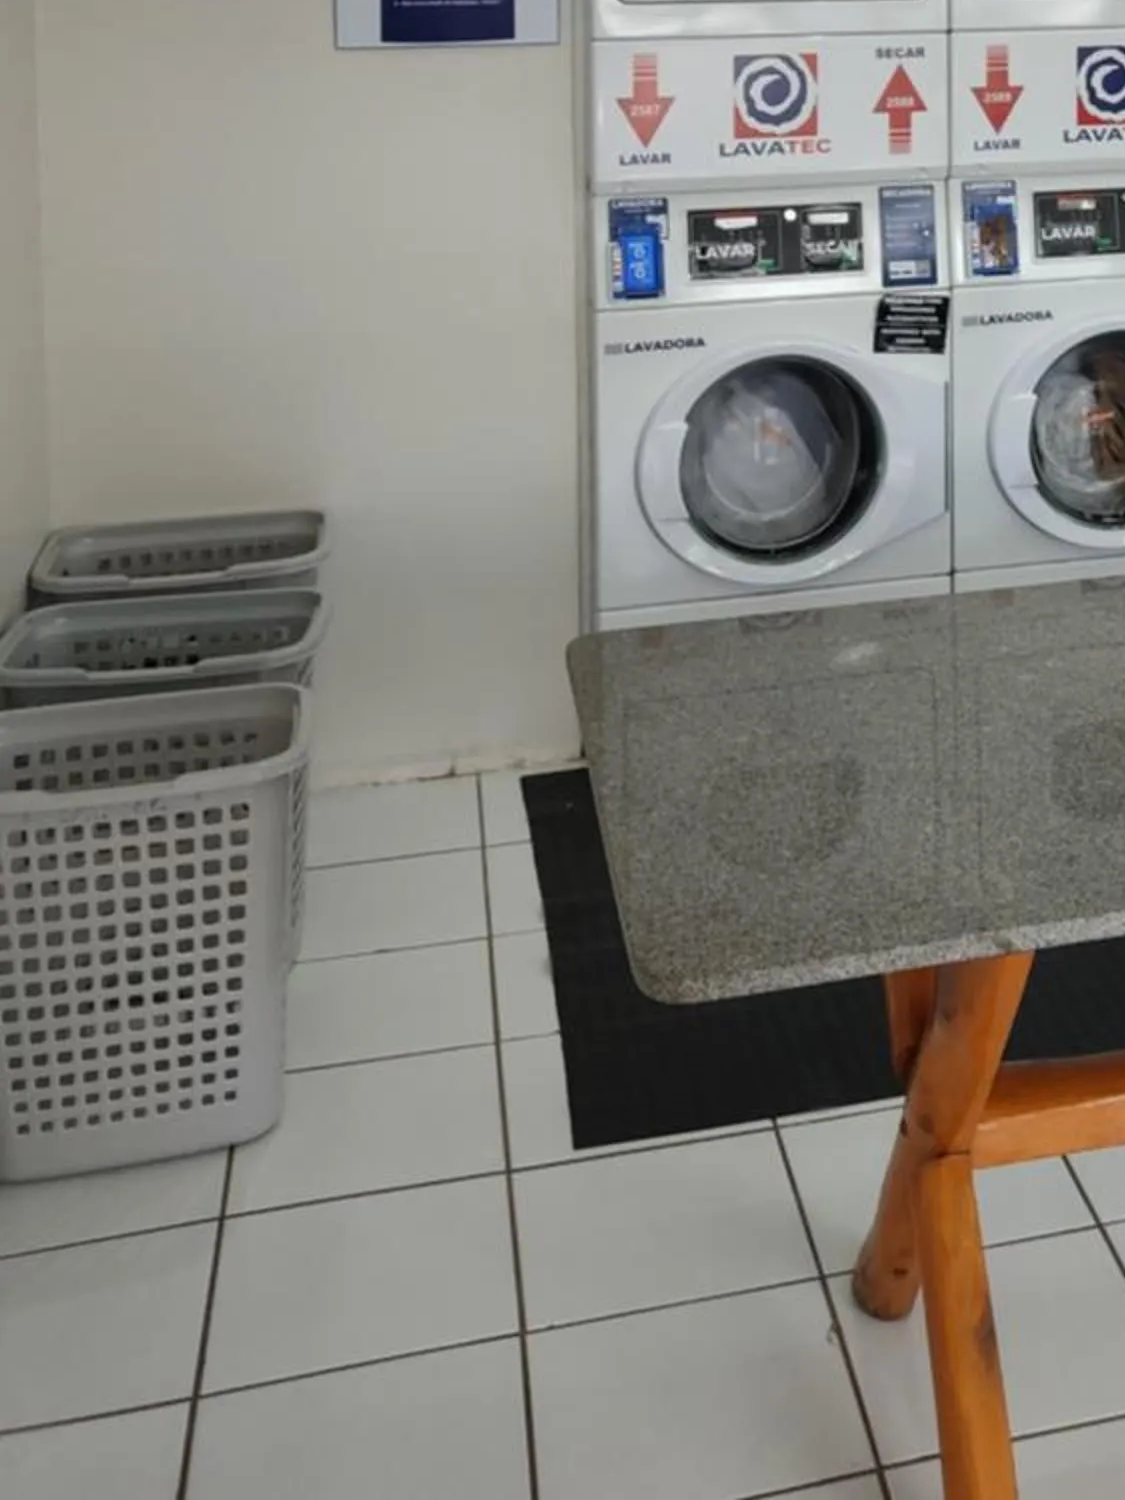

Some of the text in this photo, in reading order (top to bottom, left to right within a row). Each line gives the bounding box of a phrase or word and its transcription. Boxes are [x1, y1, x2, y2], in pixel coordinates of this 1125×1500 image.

[875, 47, 925, 59] SECAR
[719, 138, 832, 157] LAVATEC
[974, 139, 1021, 151] LAVAR
[619, 152, 672, 166] LAVAR
[1042, 226, 1096, 240] LAVAR
[695, 243, 756, 259] LAVAR
[980, 310, 1053, 326] LAVADORA
[624, 337, 706, 354] LAVADORA
